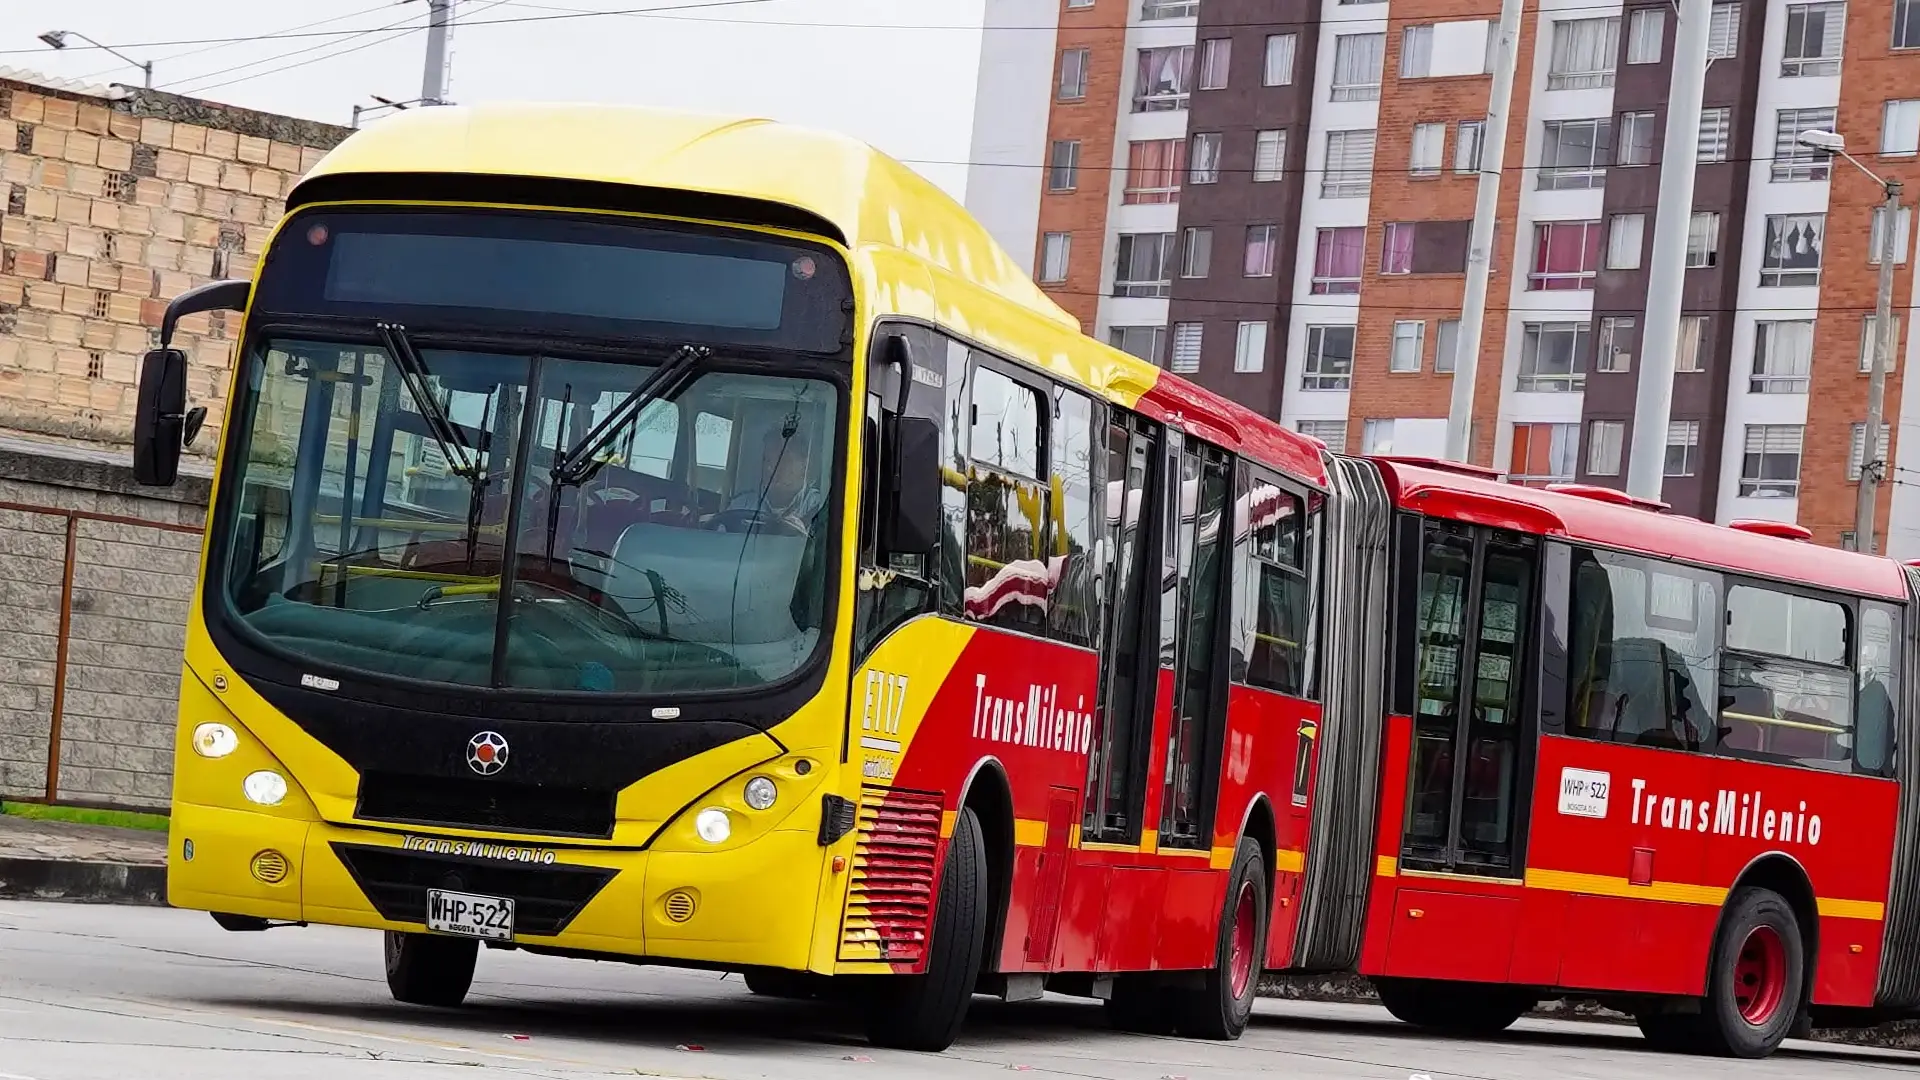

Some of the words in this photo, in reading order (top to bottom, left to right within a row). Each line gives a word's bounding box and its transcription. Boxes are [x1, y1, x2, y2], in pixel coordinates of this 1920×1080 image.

[863, 669, 908, 735] E117
[972, 673, 1091, 754] TransMilenio
[1631, 778, 1821, 846] TransMilenio
[403, 835, 555, 864] TransMilenio
